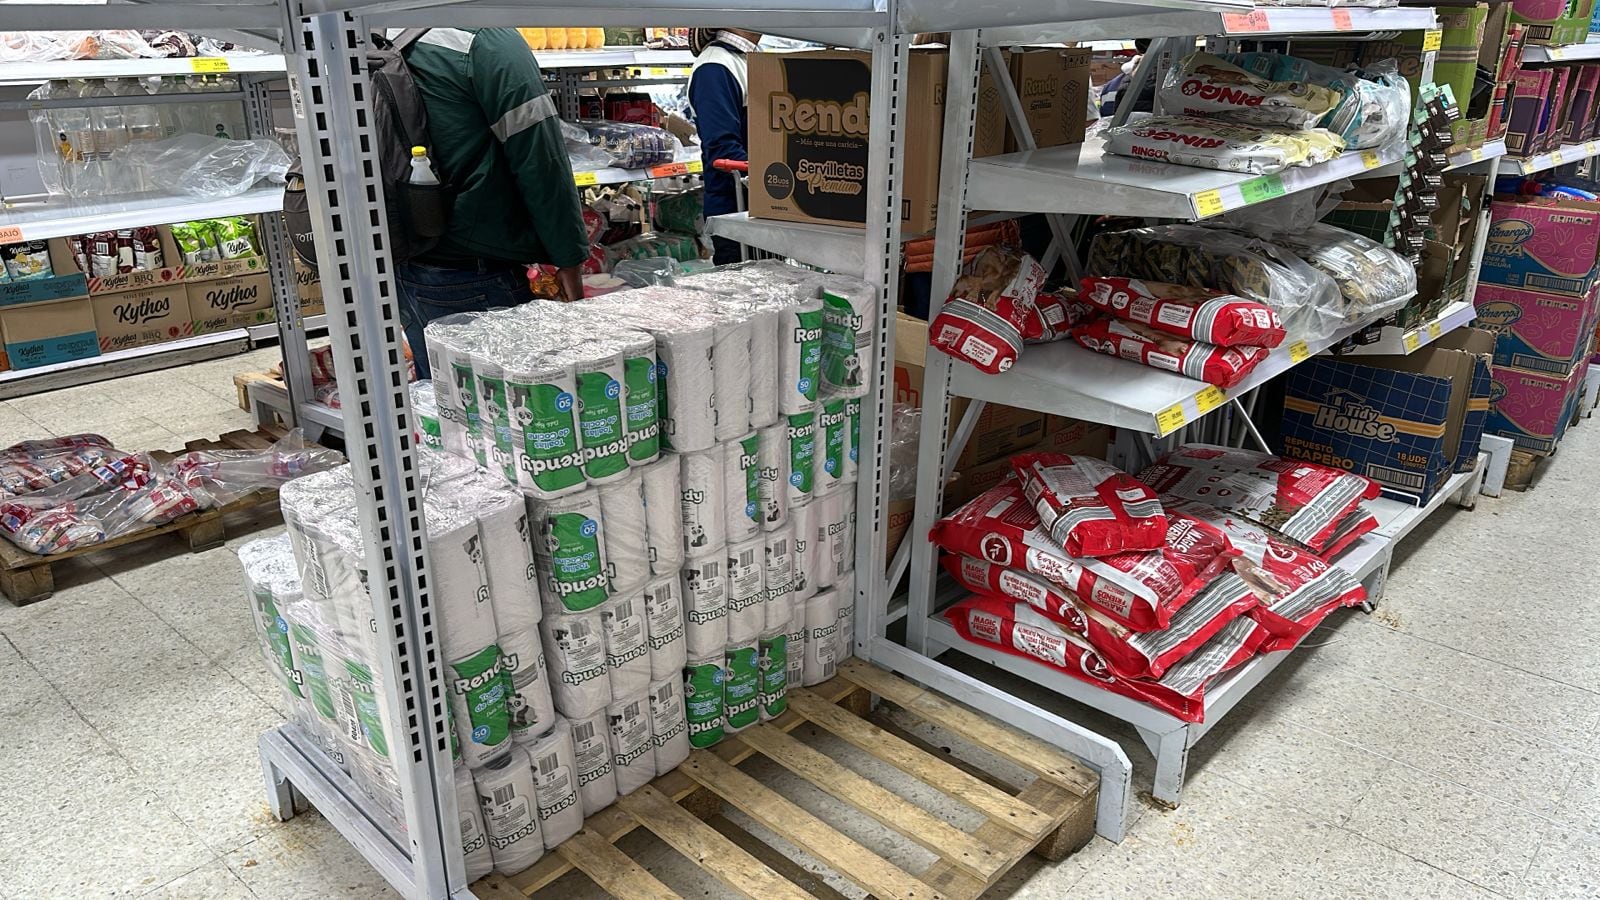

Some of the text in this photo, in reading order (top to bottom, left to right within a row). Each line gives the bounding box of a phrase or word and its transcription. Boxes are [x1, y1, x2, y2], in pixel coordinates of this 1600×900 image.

[771, 94, 870, 135] Rend
[799, 160, 864, 179] Servilletas
[796, 172, 862, 195] Premium
[1485, 243, 1523, 256] XTRA
[195, 263, 219, 275] Kythos
[103, 275, 129, 288] Kythos
[134, 274, 154, 283] BBQ
[206, 285, 258, 309] Kythos
[113, 297, 170, 324] Kythos
[800, 380, 810, 388] 50
[558, 400, 571, 408] 50
[1346, 404, 1379, 421] Tidy
[608, 415, 617, 425] de
[1315, 407, 1395, 440] House
[527, 428, 570, 445] de Cocina
[586, 426, 613, 437] Toallas
[627, 427, 658, 448] end
[534, 438, 566, 450] Toallas
[1285, 436, 1333, 453] REPUESTO
[521, 450, 585, 475] Rendy
[1284, 446, 1355, 470] TRAPERO
[1397, 452, 1427, 464] 18 UDS
[584, 525, 595, 534] 50
[548, 570, 609, 597] Rendy
[454, 653, 519, 695] Rendy
[474, 728, 487, 739] 50
[540, 791, 577, 820] Rend
